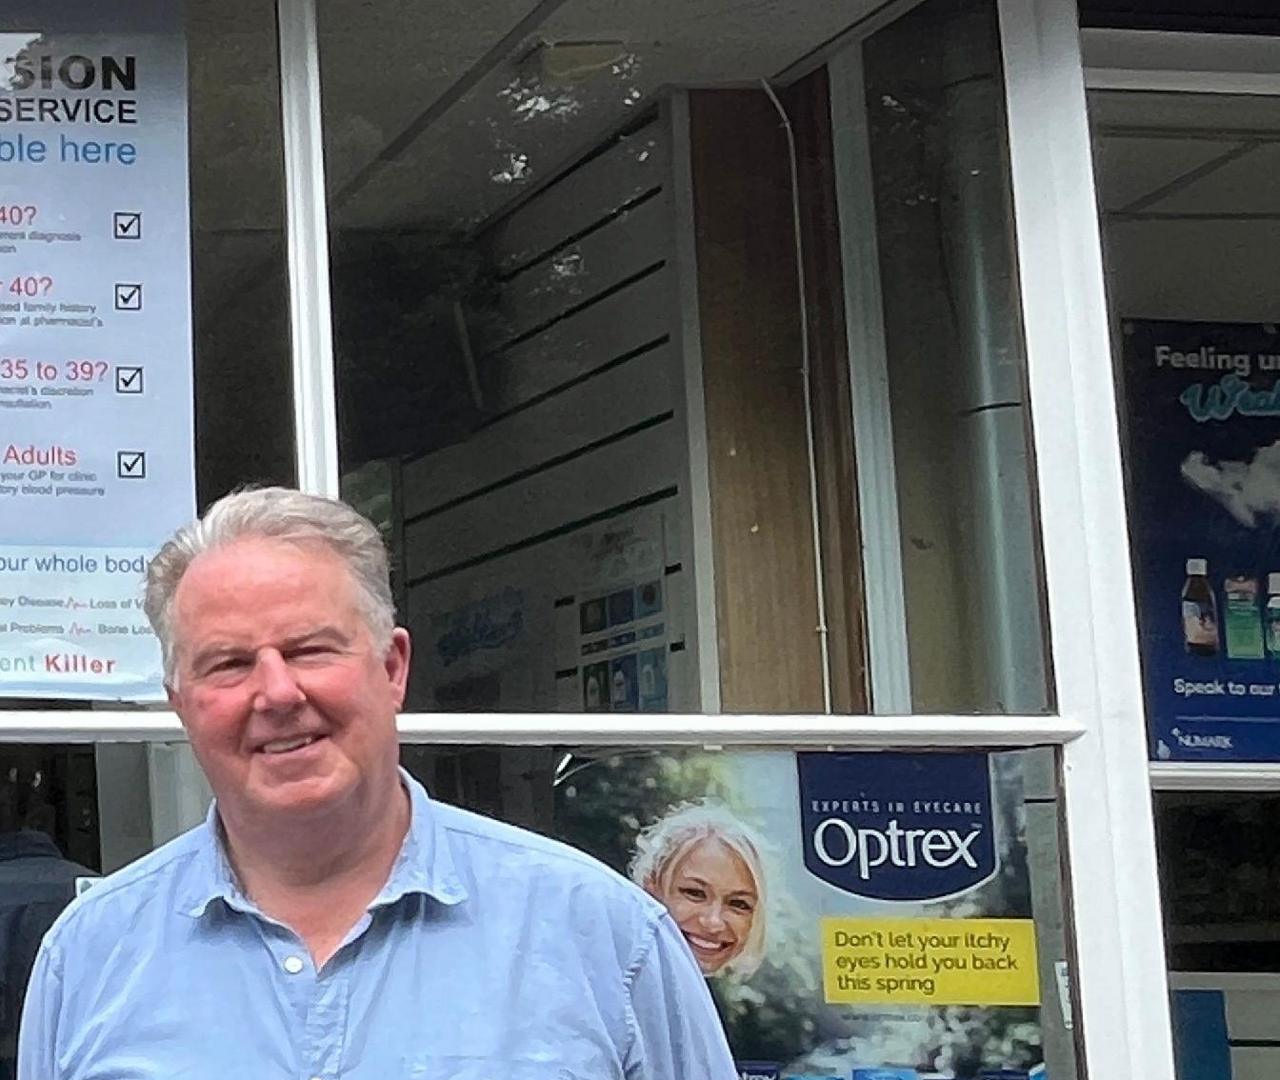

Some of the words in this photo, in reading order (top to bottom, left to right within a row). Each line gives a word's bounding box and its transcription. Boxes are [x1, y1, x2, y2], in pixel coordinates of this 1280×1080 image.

[60, 133, 137, 165] here
[28, 231, 82, 243] diagnosis
[10, 276, 53, 297] 40?
[60, 302, 97, 314] history
[0, 359, 29, 379] 35
[37, 362, 58, 380] to
[65, 360, 109, 382] 39?
[1154, 345, 1251, 377] Feeling
[3, 444, 77, 466] Adults
[1, 471, 25, 483] your
[28, 471, 47, 481] GP
[50, 471, 65, 481] for
[68, 471, 97, 481] clinic
[55, 486, 105, 497] pressure
[35, 554, 98, 573] whole
[105, 554, 148, 573] bod
[18, 596, 65, 607] Disease
[90, 597, 117, 609] Loss
[10, 622, 65, 634] Problems
[98, 623, 129, 634] Bone
[45, 653, 117, 674] Killer
[1173, 678, 1226, 698] Speak
[1227, 681, 1246, 696] to
[811, 799, 880, 814] EXPERTS
[888, 800, 905, 813] IN
[914, 800, 982, 815] EYECARE
[813, 817, 982, 881] Optrex
[834, 930, 884, 948] Don't
[888, 931, 915, 949] let
[917, 935, 960, 952] your
[964, 932, 1010, 953] itchy
[836, 955, 881, 972] eyes
[885, 953, 928, 969] hold
[931, 956, 967, 974] you
[972, 954, 1018, 971] back
[838, 975, 871, 991] this
[876, 976, 936, 996] spring
